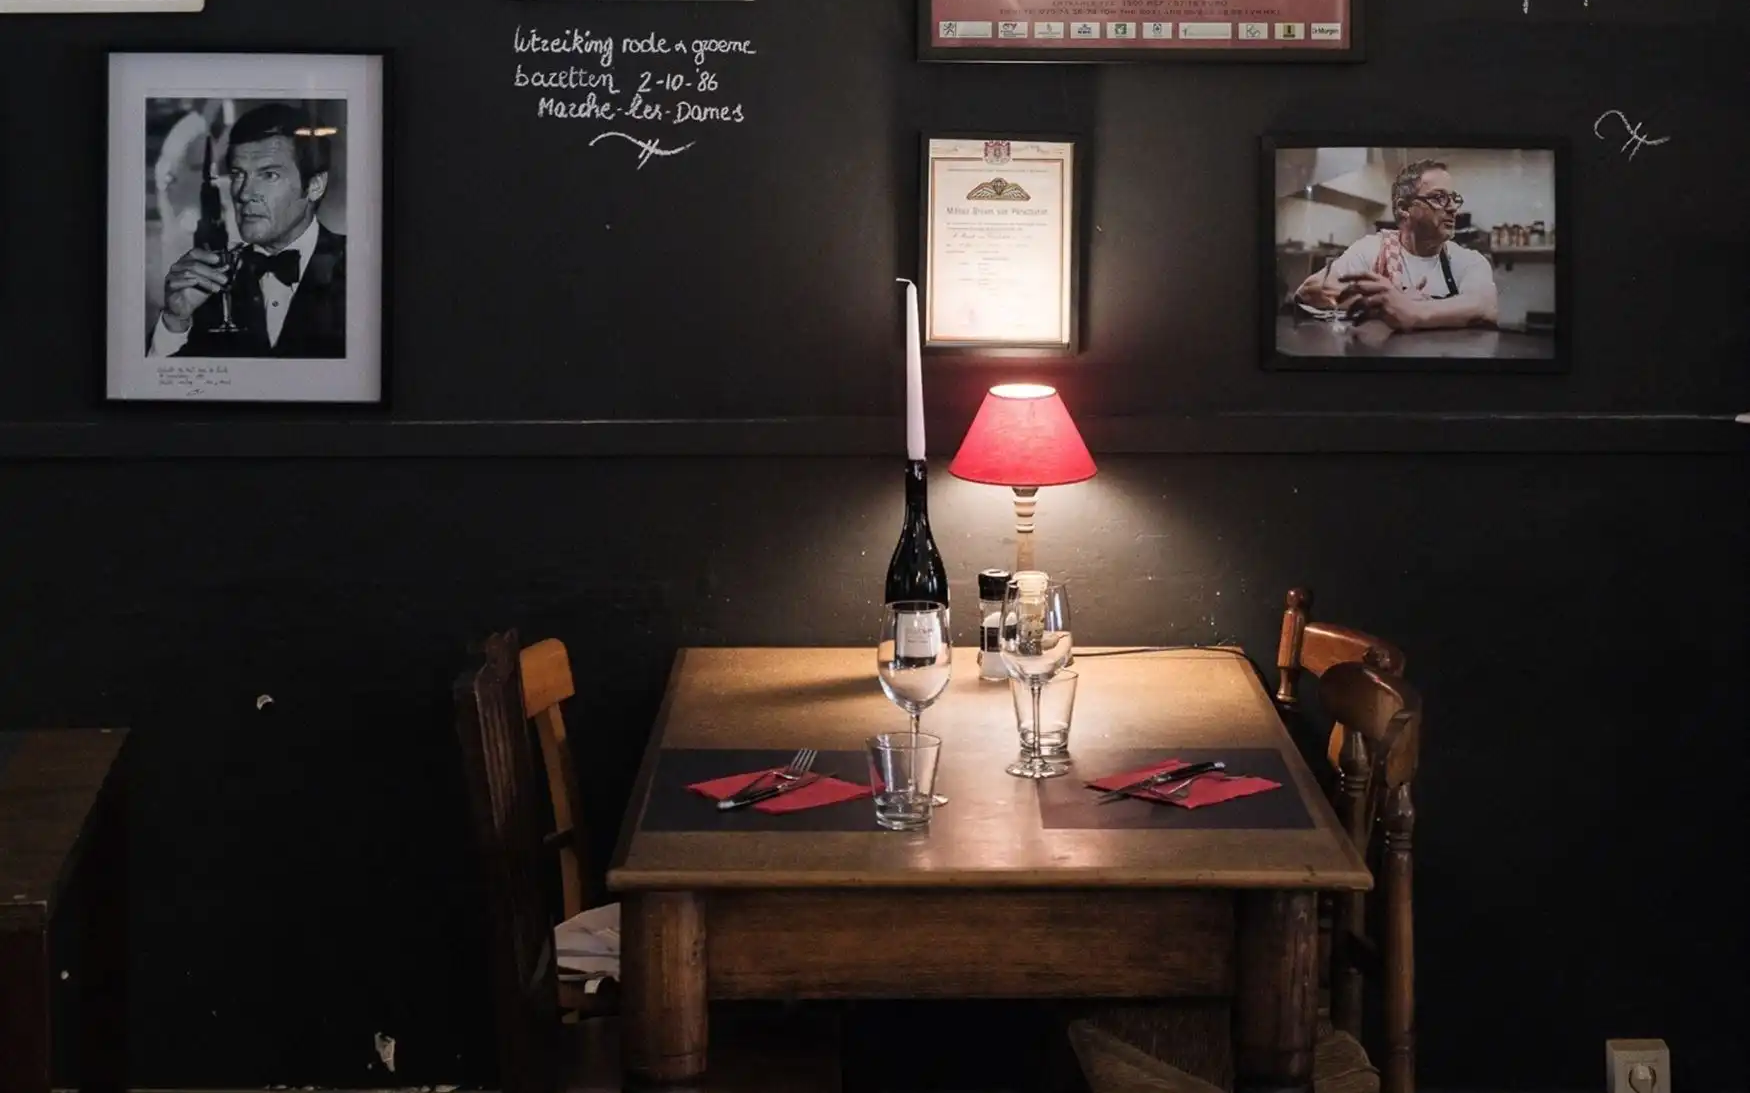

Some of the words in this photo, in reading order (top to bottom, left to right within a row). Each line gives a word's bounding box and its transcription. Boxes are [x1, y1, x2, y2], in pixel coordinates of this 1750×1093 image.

[514, 24, 613, 67] Uitreiking
[621, 32, 671, 53] rode
[691, 39, 756, 65] groene
[514, 64, 620, 94] baretten
